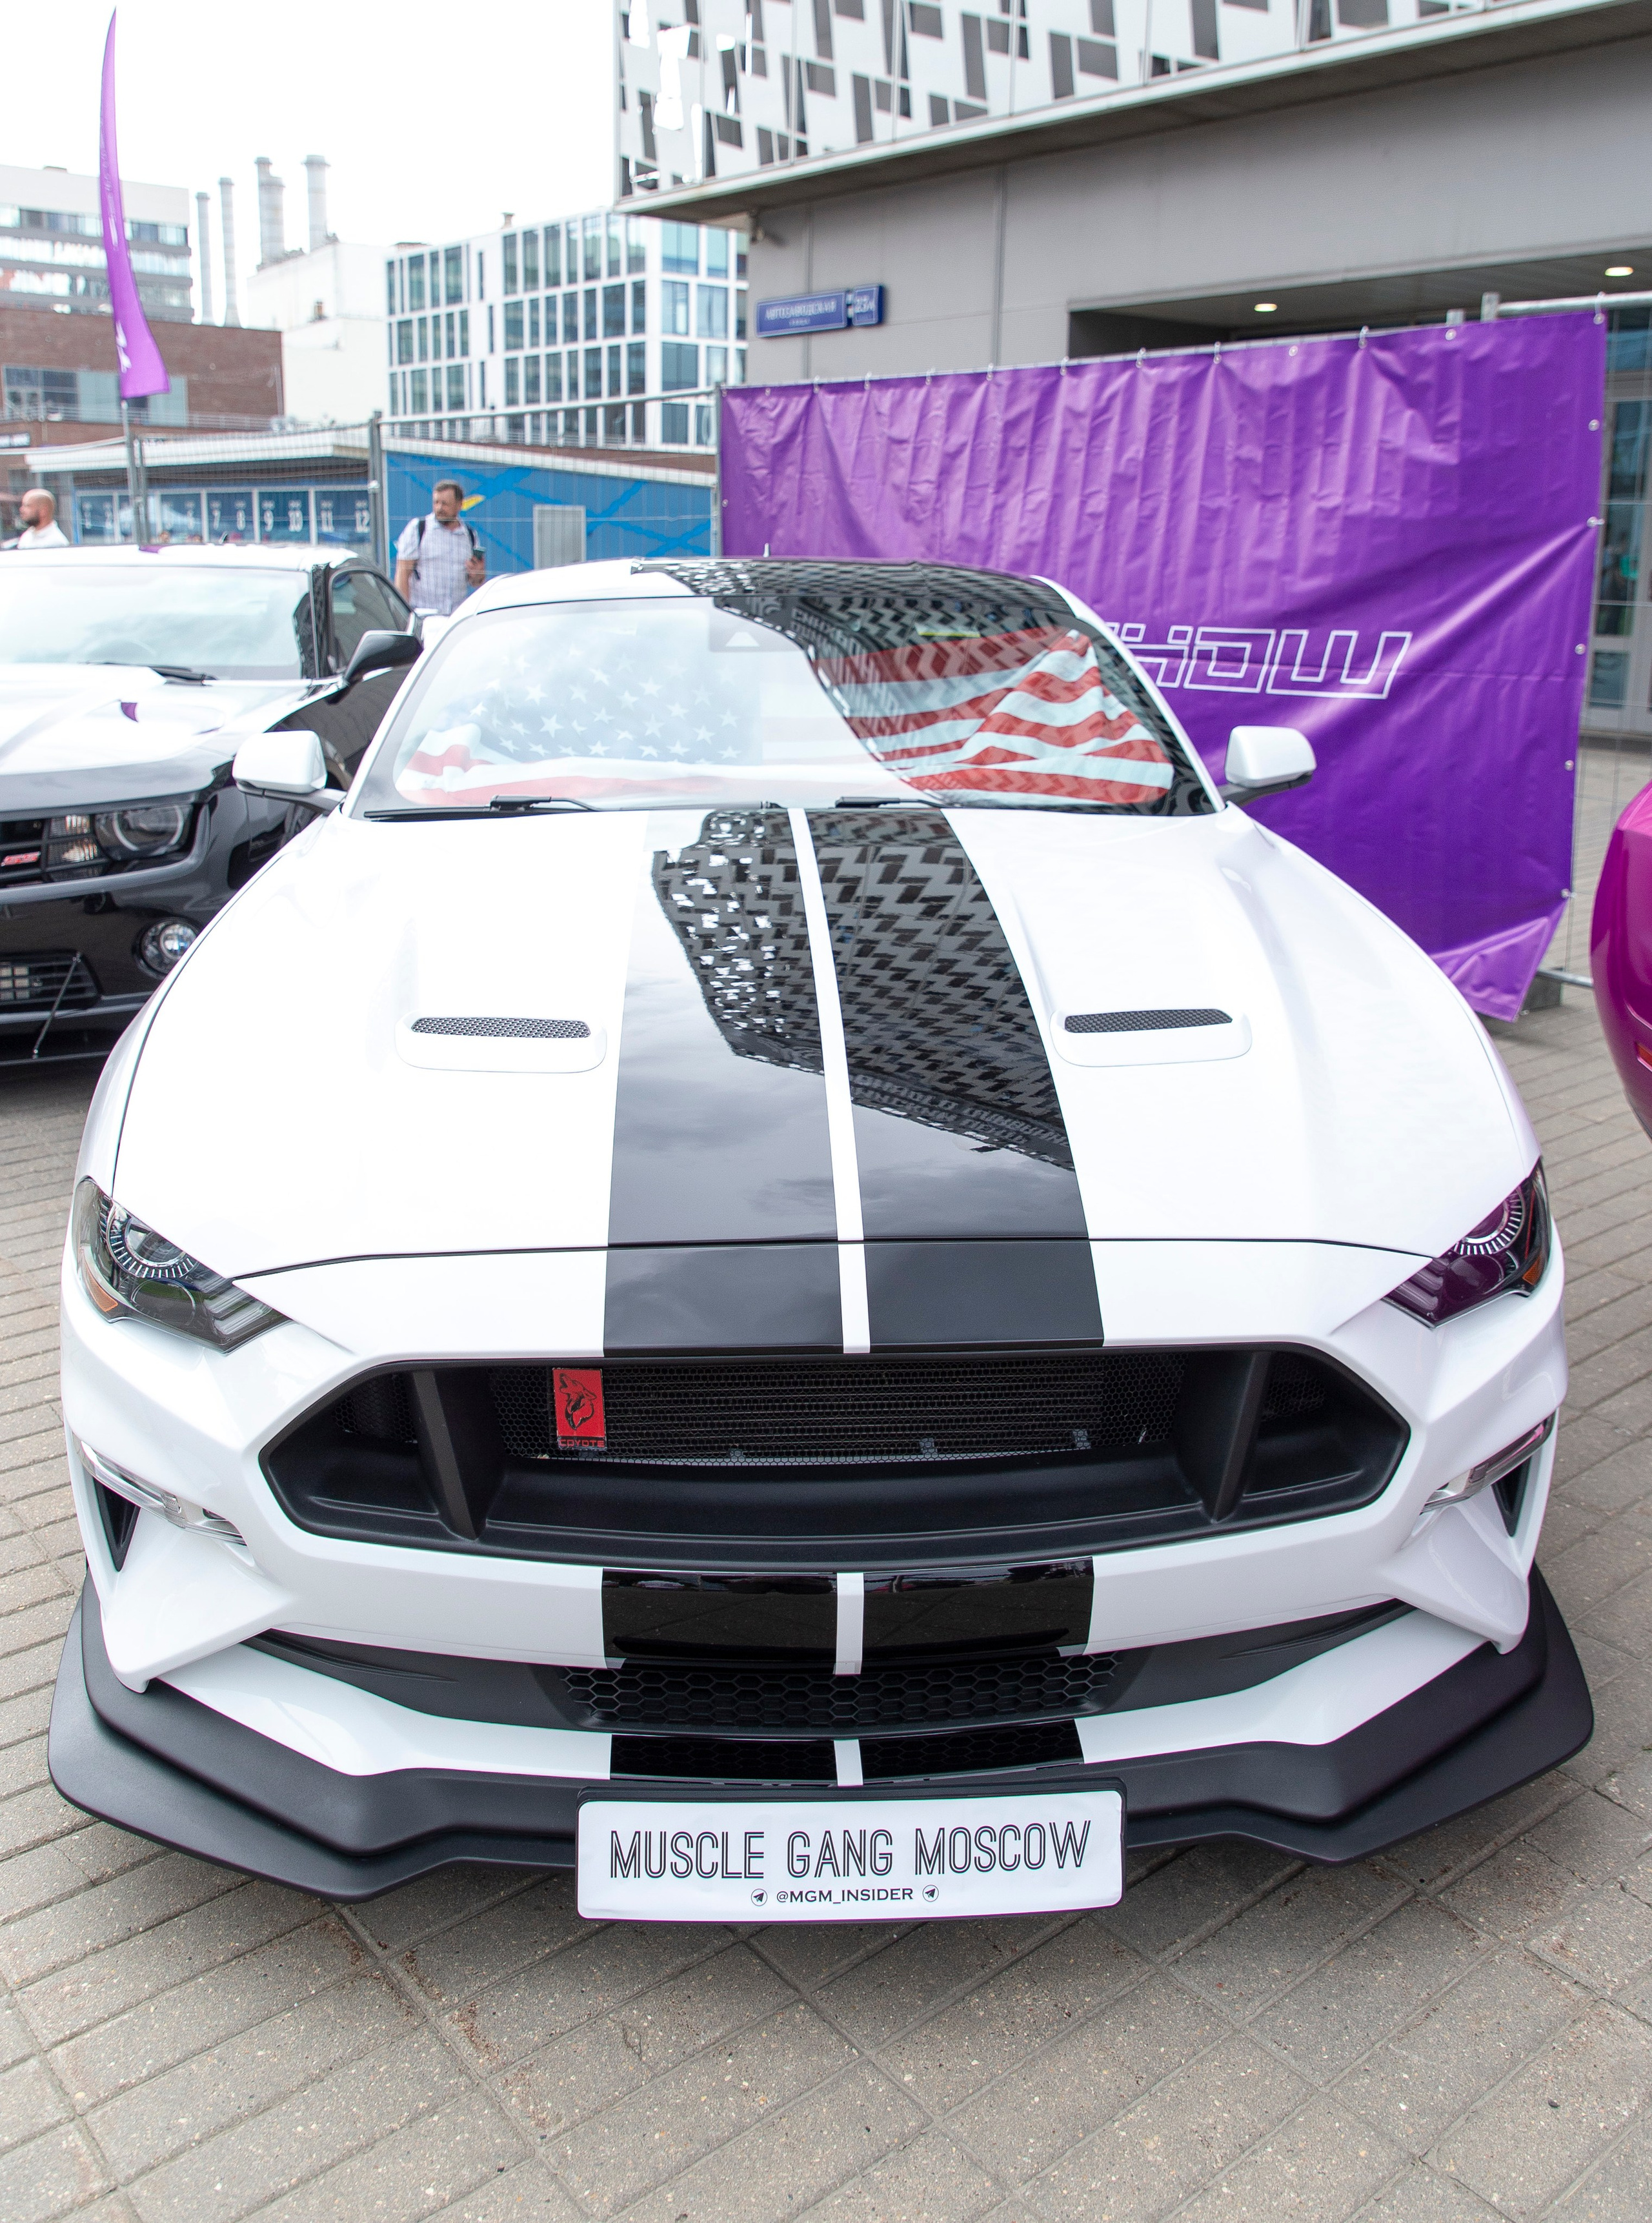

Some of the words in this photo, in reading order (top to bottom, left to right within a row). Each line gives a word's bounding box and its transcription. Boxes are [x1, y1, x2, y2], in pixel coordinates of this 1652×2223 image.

[1105, 621, 1413, 699] HOW
[558, 1439, 605, 1447] COYOTE
[610, 1830, 765, 1879] MUSCLE
[787, 1829, 893, 1878] GANG
[915, 1820, 1091, 1875] MOSCOW
[776, 1887, 913, 1904] @MGM_INSIDER
